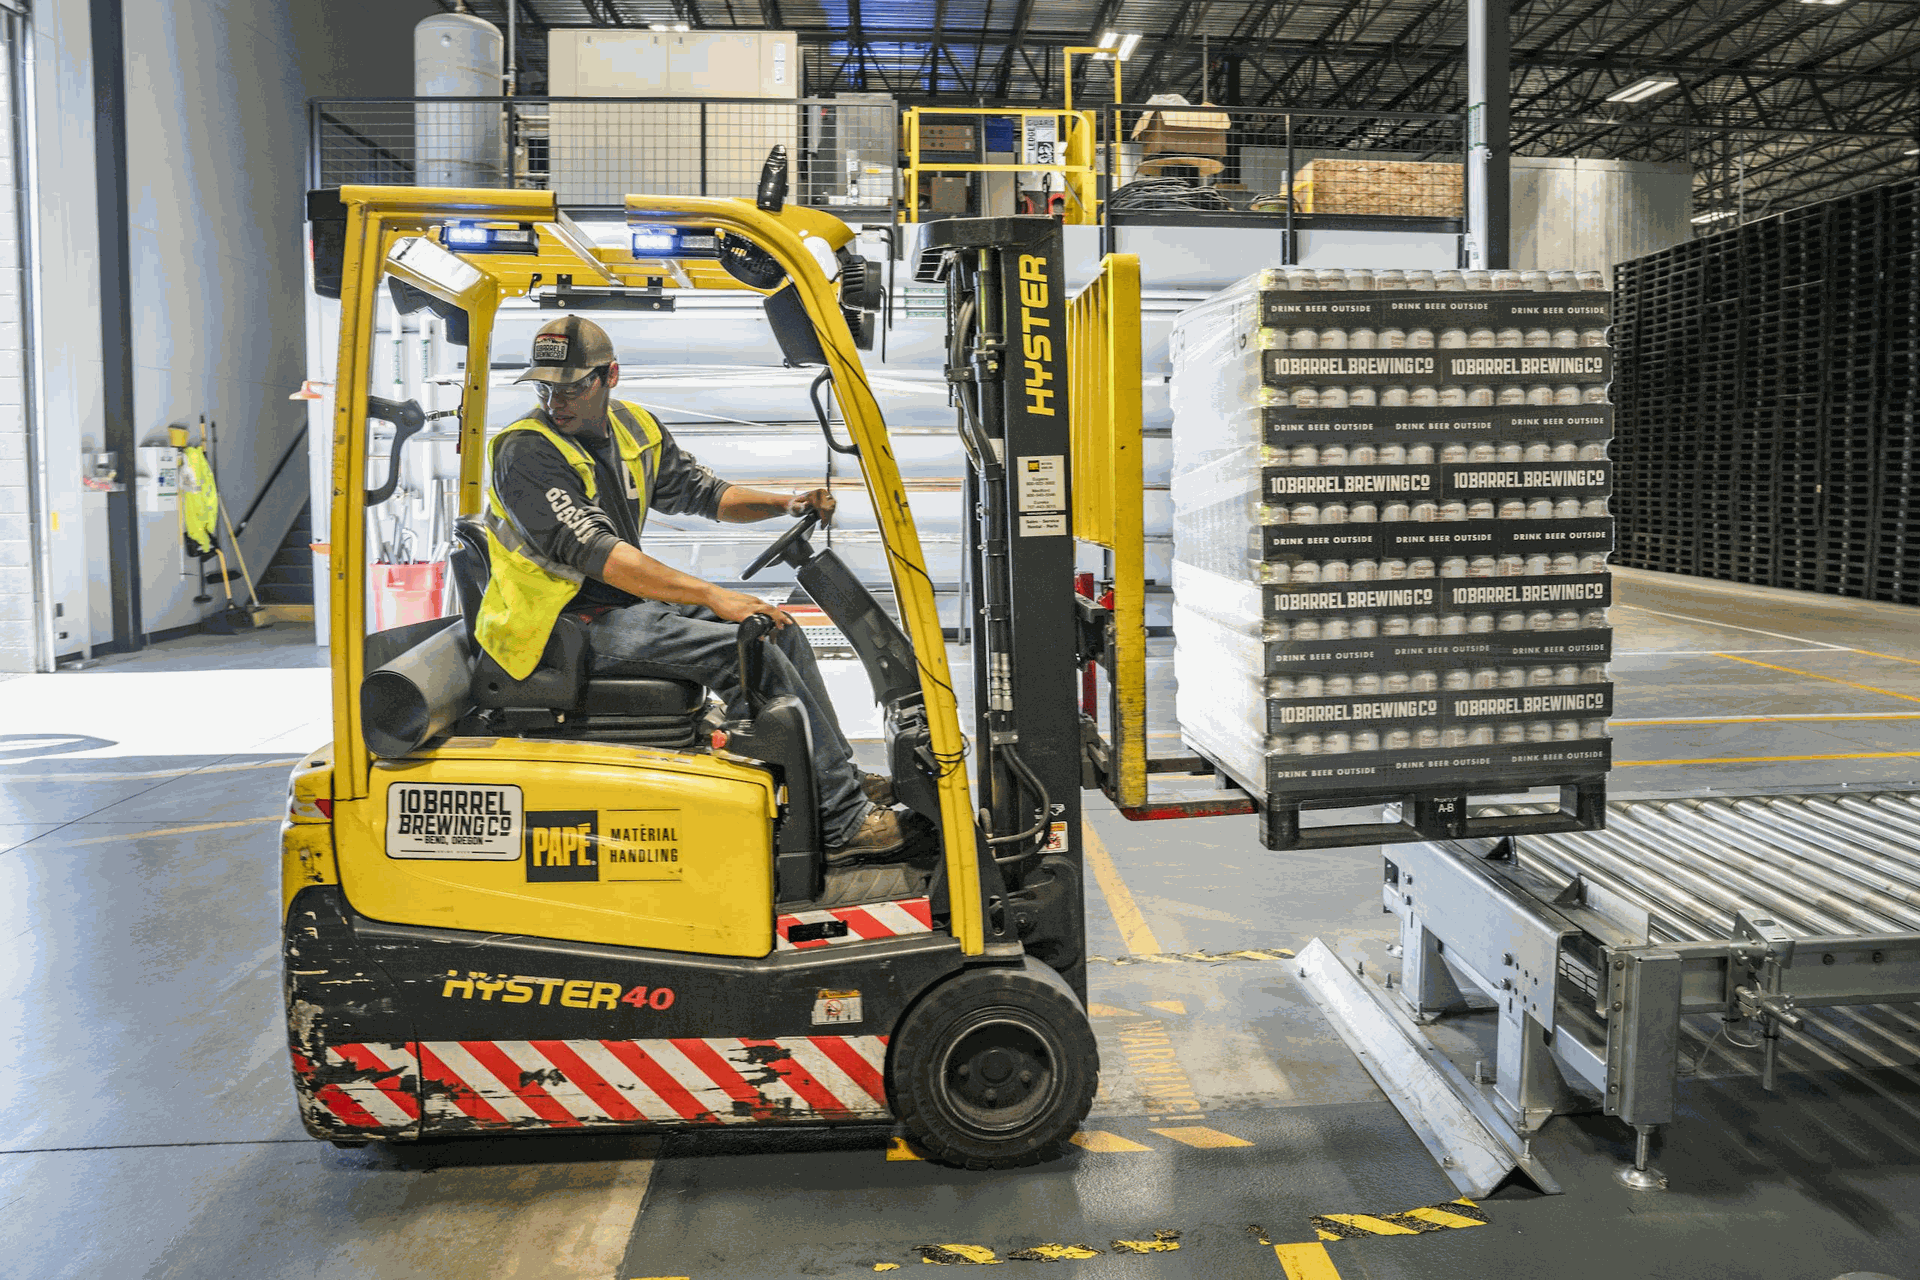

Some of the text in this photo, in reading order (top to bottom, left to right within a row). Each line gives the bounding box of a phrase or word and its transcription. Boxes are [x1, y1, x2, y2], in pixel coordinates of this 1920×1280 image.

[1271, 305, 1371, 313] DRINK BEER OUTSIDE
[1391, 302, 1488, 310] DRINK BEER OUTSIDE
[1567, 306, 1605, 314] OUTSIDE
[1018, 254, 1056, 417] HYSTER
[1395, 422, 1492, 430] DRINK BEER OUTSIDE
[1511, 417, 1604, 426] DRINK BEER OUTSIDE
[1274, 423, 1373, 432] DRINK BEER OUTSIDE
[1273, 535, 1373, 546] DRINK BEER OUTSIDE
[1395, 533, 1492, 544] DRINK BEER OUTSIDE
[1513, 531, 1606, 541] DRINK BEER OUTSIDE
[1394, 644, 1490, 656] DRINK BEER OUTSIDE
[1512, 643, 1604, 655] DRINK BEER OUTSIDE
[1275, 651, 1374, 662] DRINK BEER OUTSIDE
[1511, 750, 1603, 763] DRINK BEER OUTSIDE
[1395, 757, 1490, 769] DRINK BEER OUTSIDE
[1277, 766, 1376, 779] DRINK BEER OUTSIDE
[1438, 803, 1455, 813] A-B
[451, 836, 484, 846] OREGON
[610, 848, 678, 863] HANDLING
[621, 985, 676, 1011] 40
